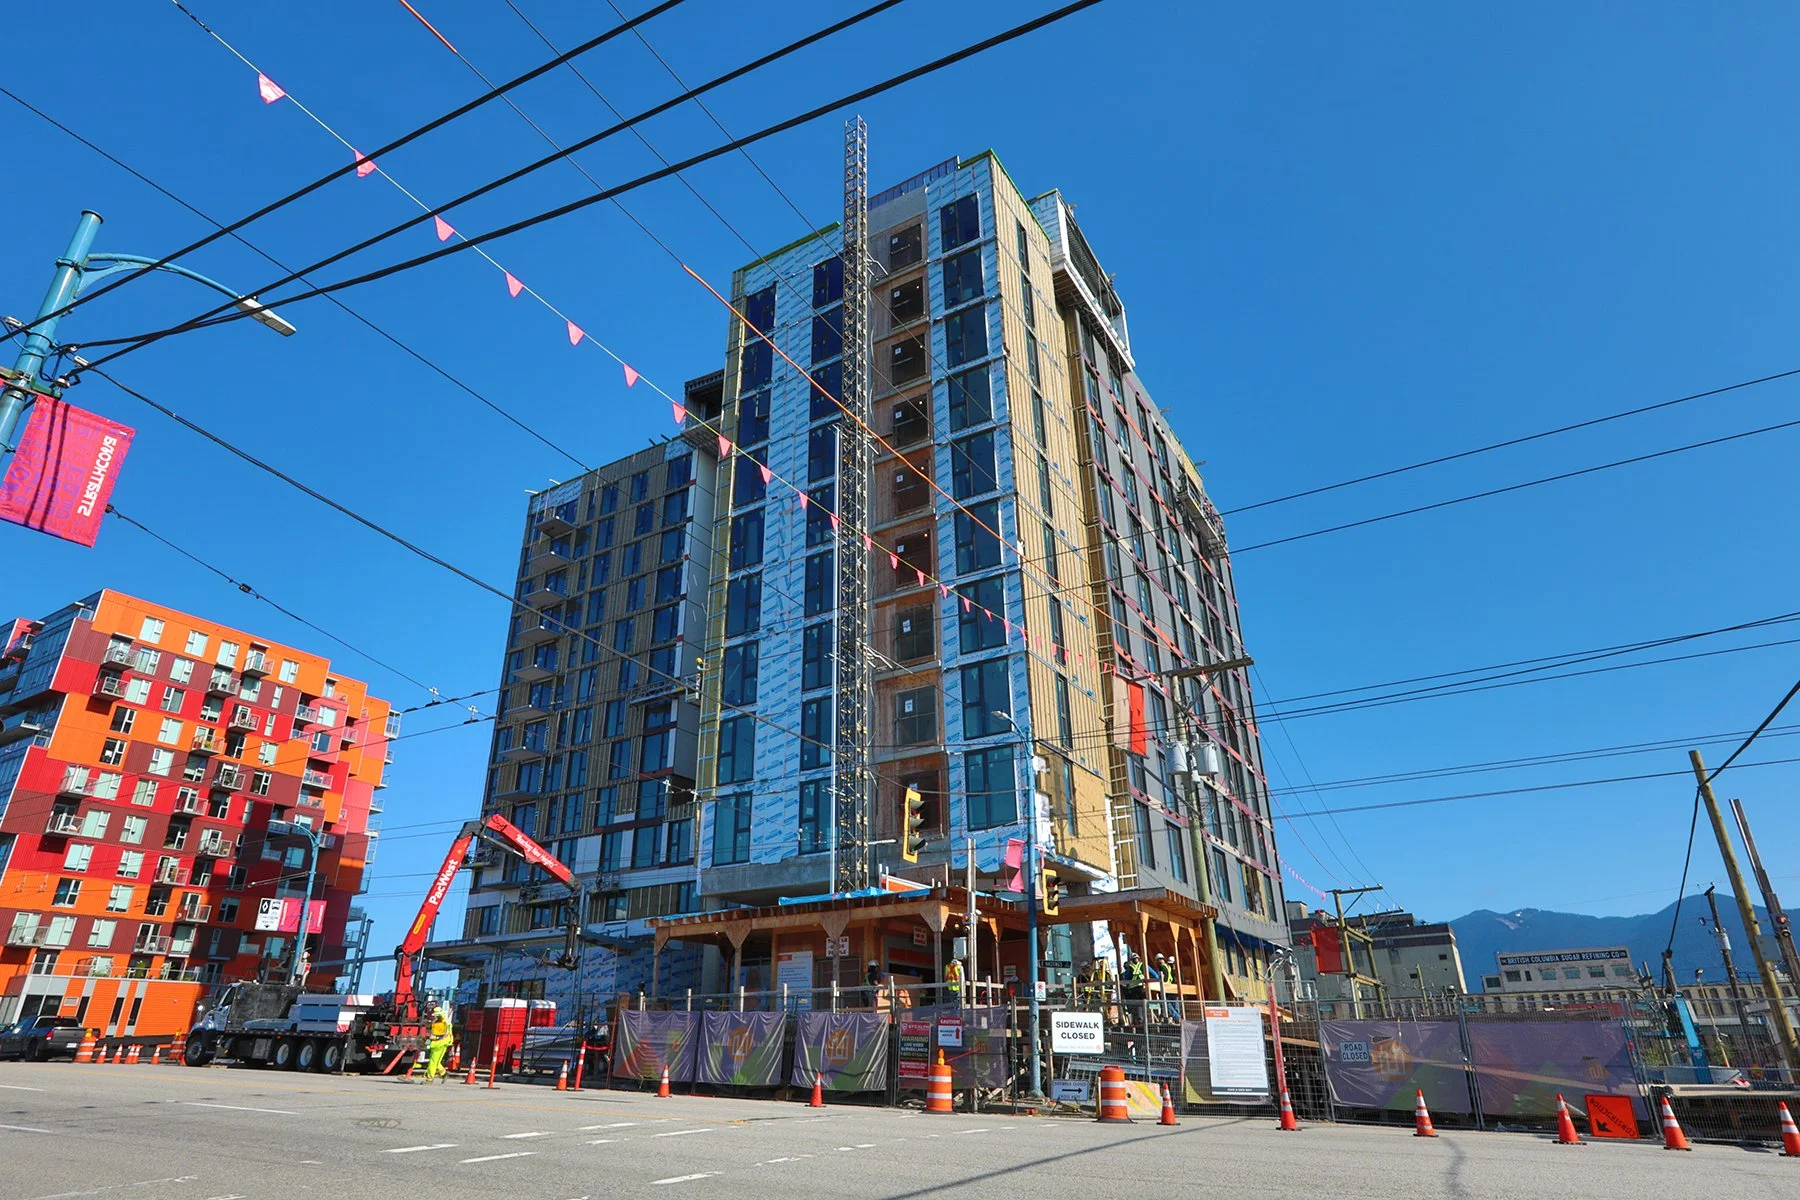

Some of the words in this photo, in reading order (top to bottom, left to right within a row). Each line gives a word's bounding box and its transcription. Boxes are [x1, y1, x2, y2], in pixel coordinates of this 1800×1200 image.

[428, 859, 458, 905] PacWest
[1530, 955, 1560, 963] COLUMBIA
[1581, 952, 1610, 960] REFINING
[1055, 1021, 1099, 1029] SIDEWALK
[1061, 1032, 1095, 1040] CLOSED
[1344, 1043, 1363, 1051] ROAD
[1342, 1052, 1368, 1060] CLOSED
[1590, 1097, 1636, 1137] CONSTRUCTION
